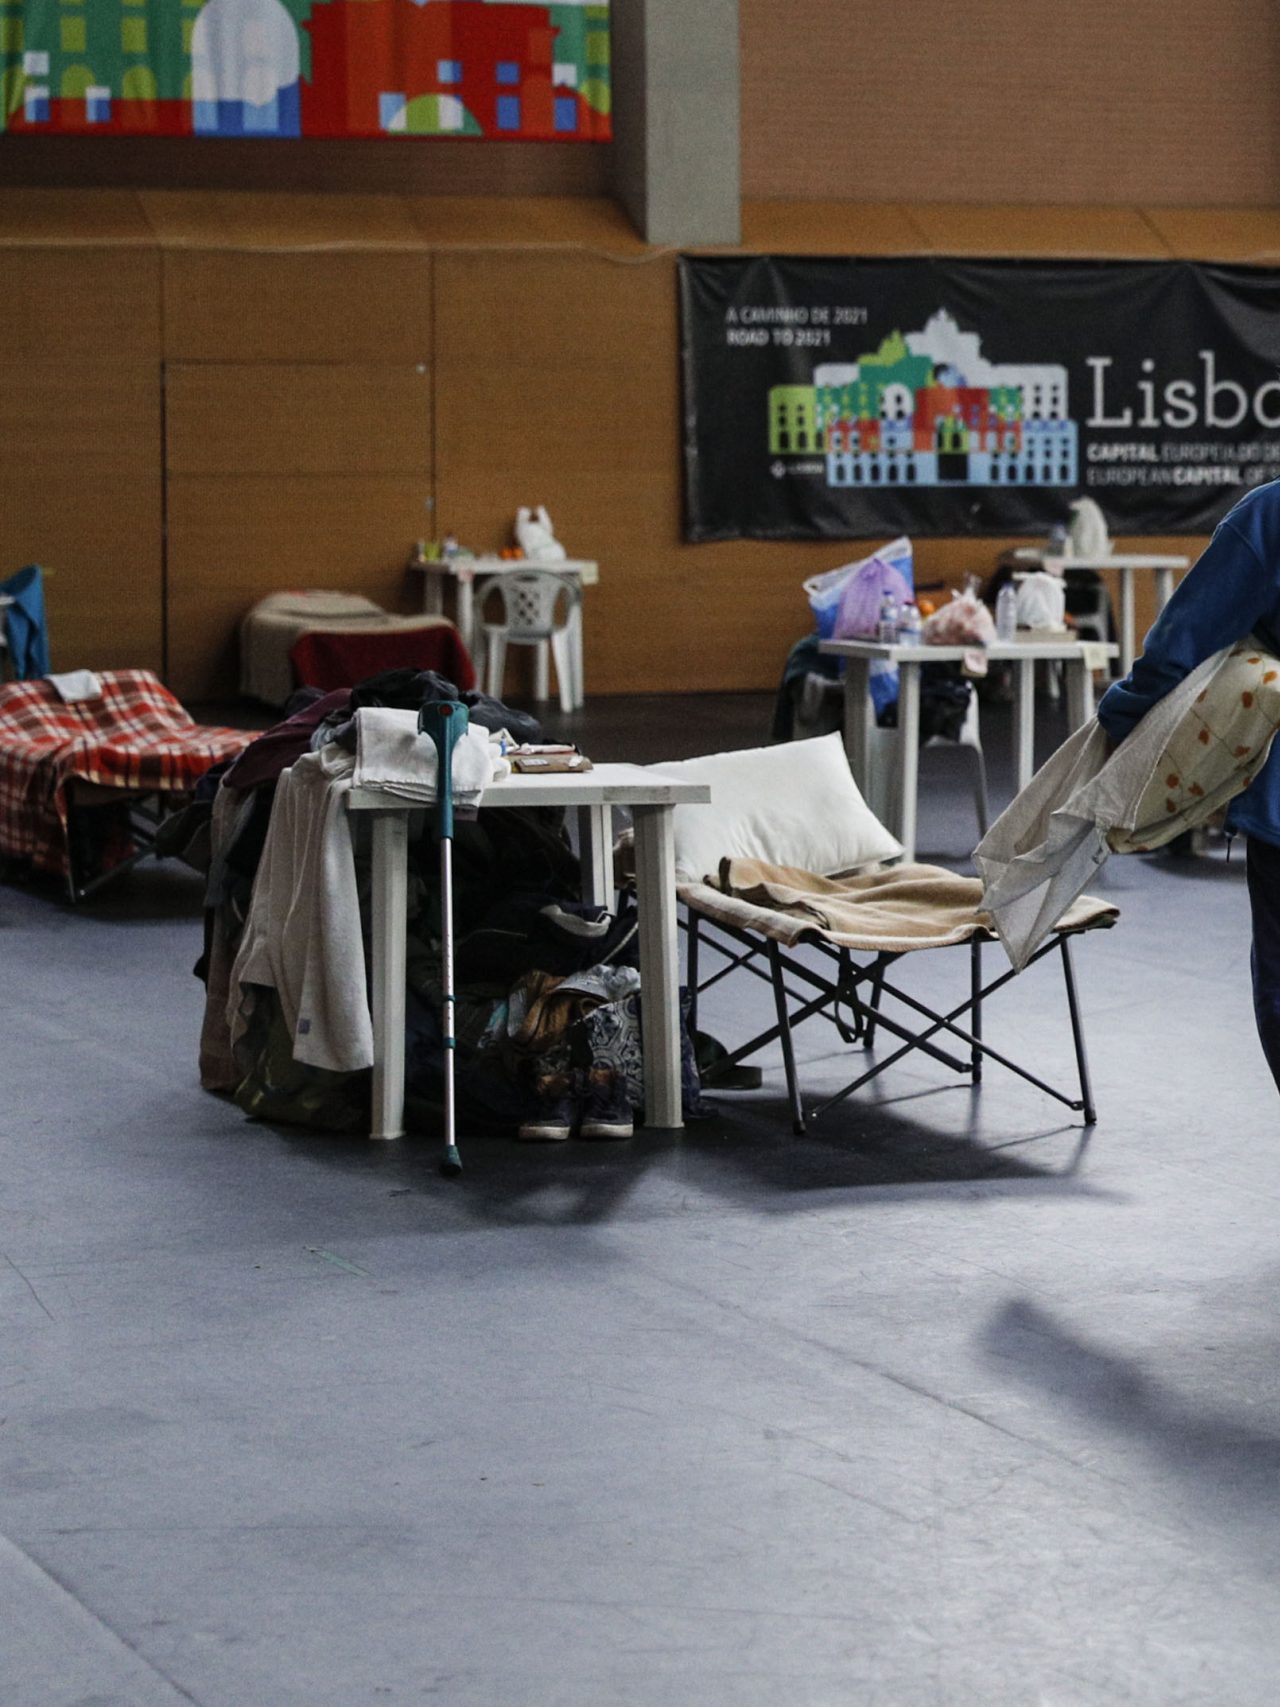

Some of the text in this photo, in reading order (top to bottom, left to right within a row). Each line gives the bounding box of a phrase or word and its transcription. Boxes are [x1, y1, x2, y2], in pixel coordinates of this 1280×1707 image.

[726, 306, 867, 325] A CAMINHO DE 2021
[726, 328, 831, 346] ROAD TO 2021
[1087, 443, 1158, 463] CAPITAL
[1086, 466, 1172, 485] EUROPEAN
[1173, 465, 1243, 486] CAPITAL
